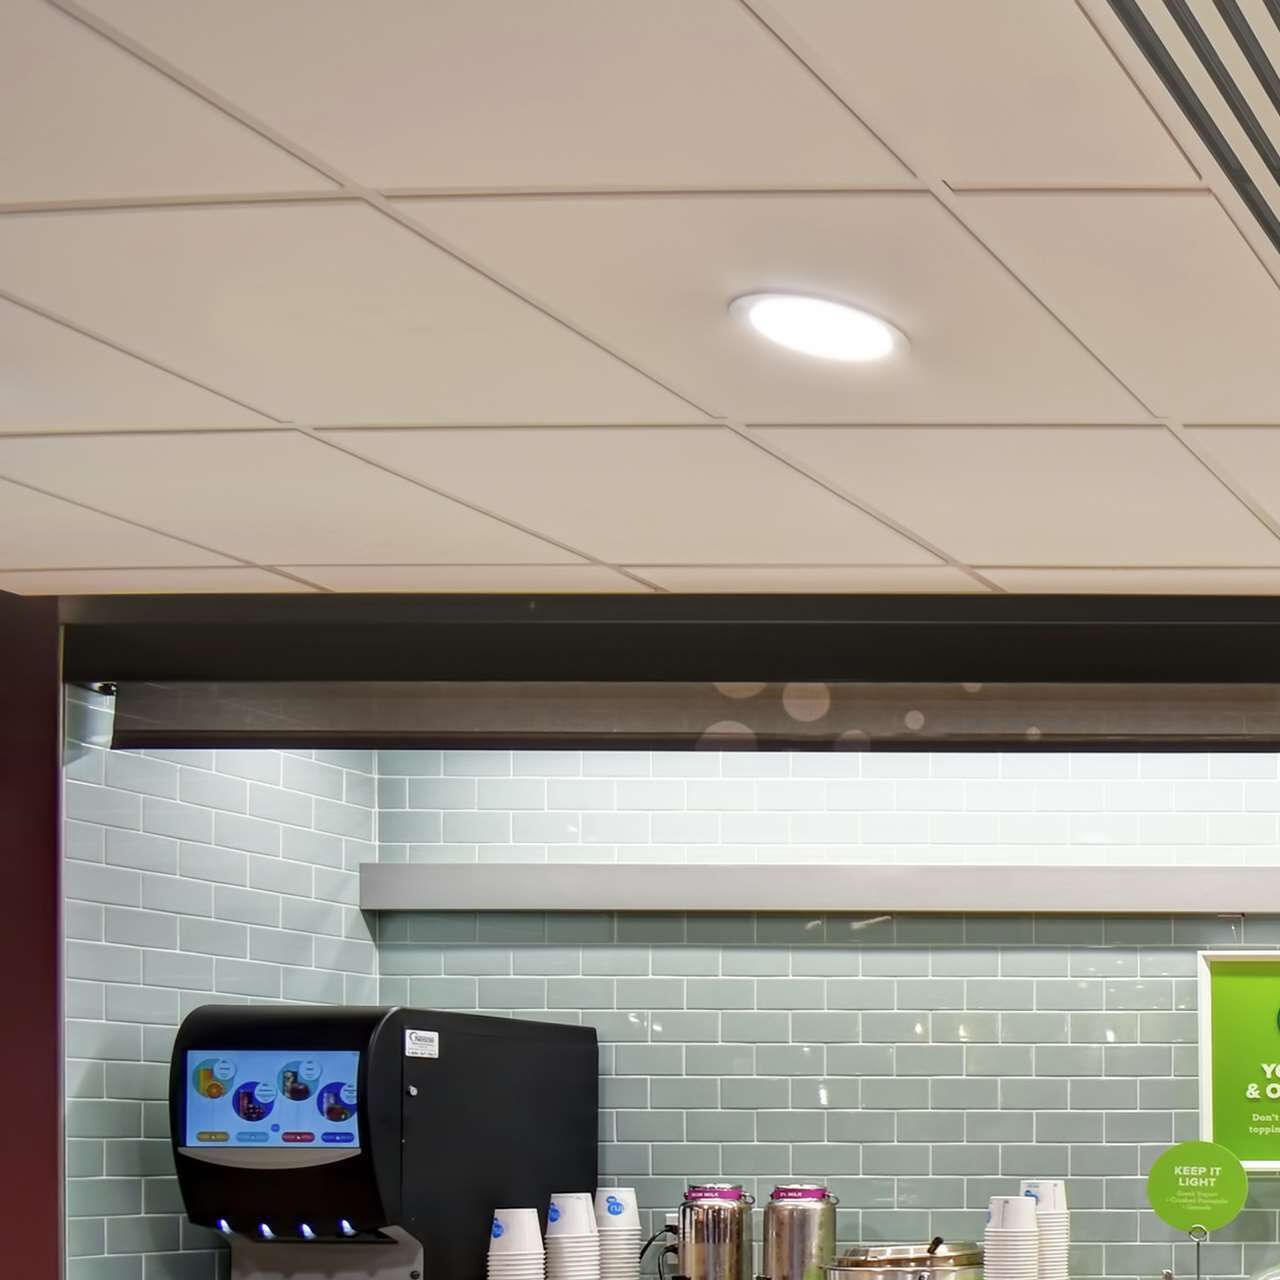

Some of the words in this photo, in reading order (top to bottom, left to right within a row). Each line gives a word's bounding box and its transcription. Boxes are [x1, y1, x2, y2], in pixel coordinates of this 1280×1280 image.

[1246, 1083, 1261, 1099] &
[1252, 1113, 1279, 1122] Don't
[1174, 1166, 1207, 1176] KEEP
[1210, 1167, 1222, 1177] IT
[1178, 1177, 1217, 1187] LIGHT
